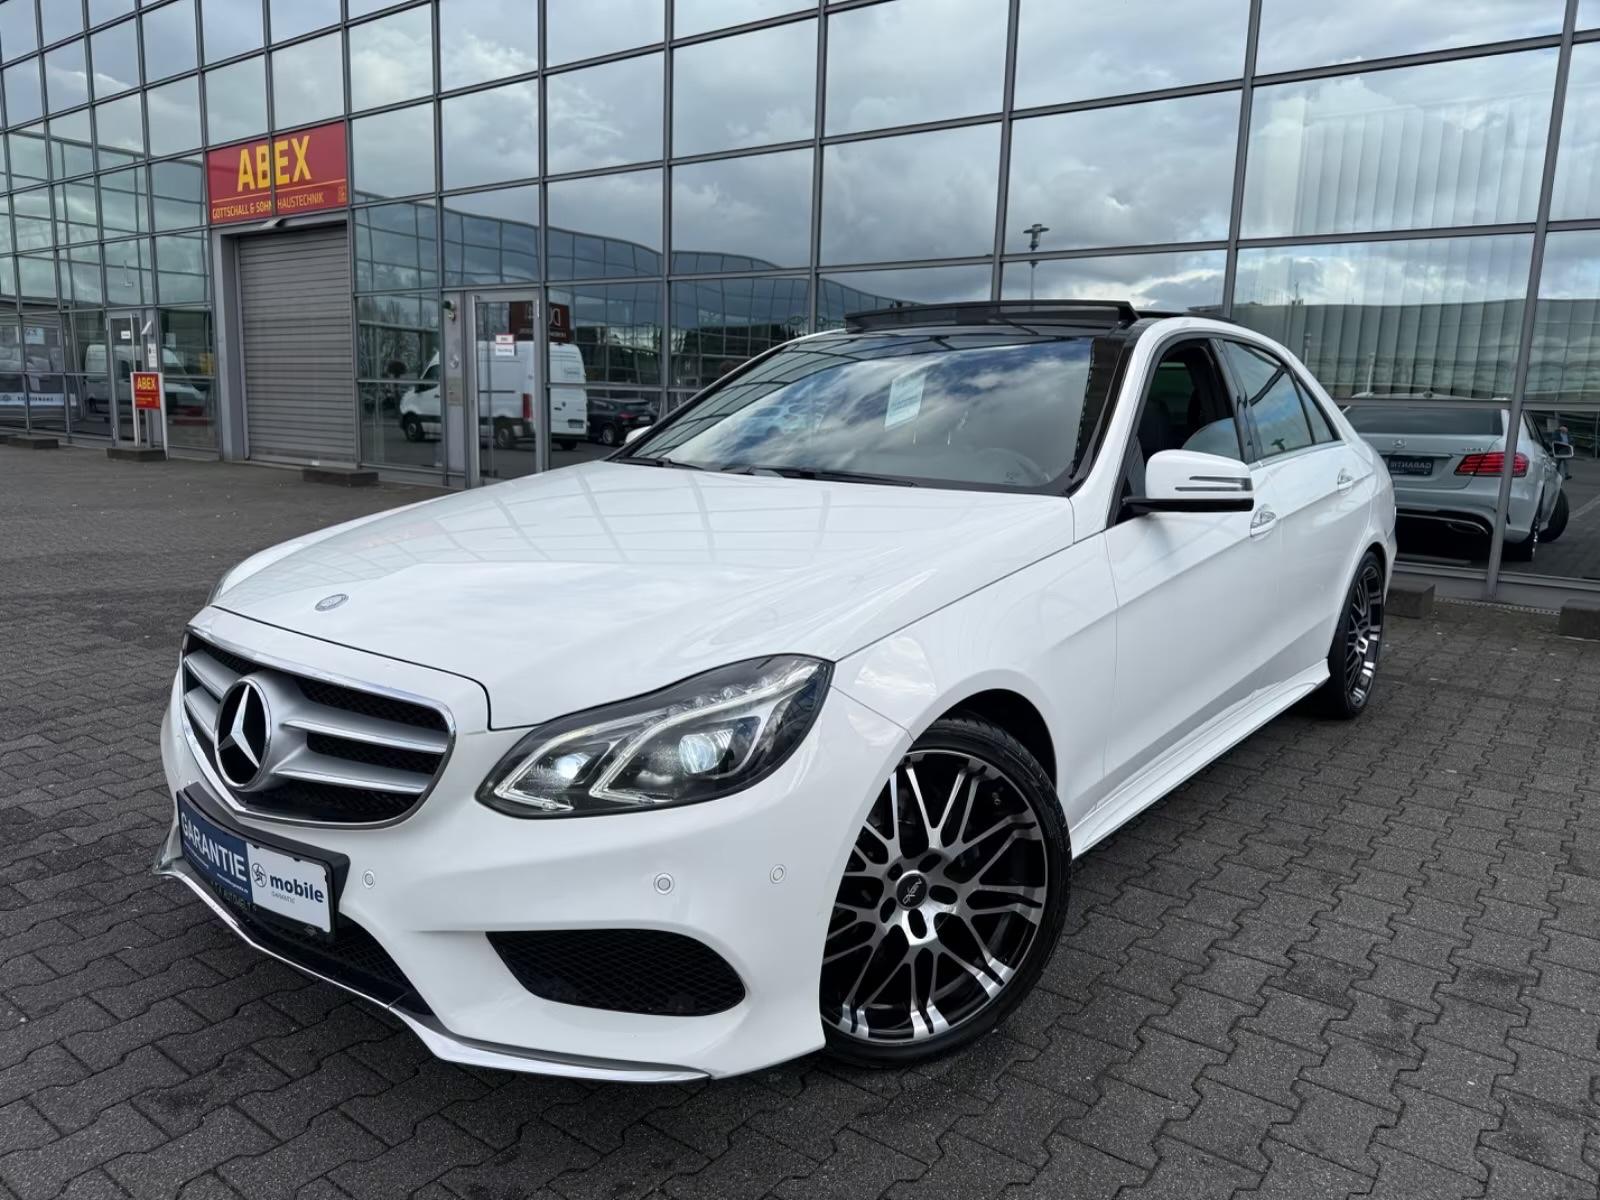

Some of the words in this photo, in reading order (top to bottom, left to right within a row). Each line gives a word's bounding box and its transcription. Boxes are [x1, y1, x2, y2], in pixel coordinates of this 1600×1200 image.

[237, 135, 312, 192] ABEX
[212, 203, 249, 219] GOTTSCHALL
[250, 202, 255, 214] &
[277, 192, 324, 209] HAUSTECHNIK
[137, 376, 156, 390] ABEX
[181, 811, 247, 882] GARANTIE
[270, 874, 324, 903] mobile
